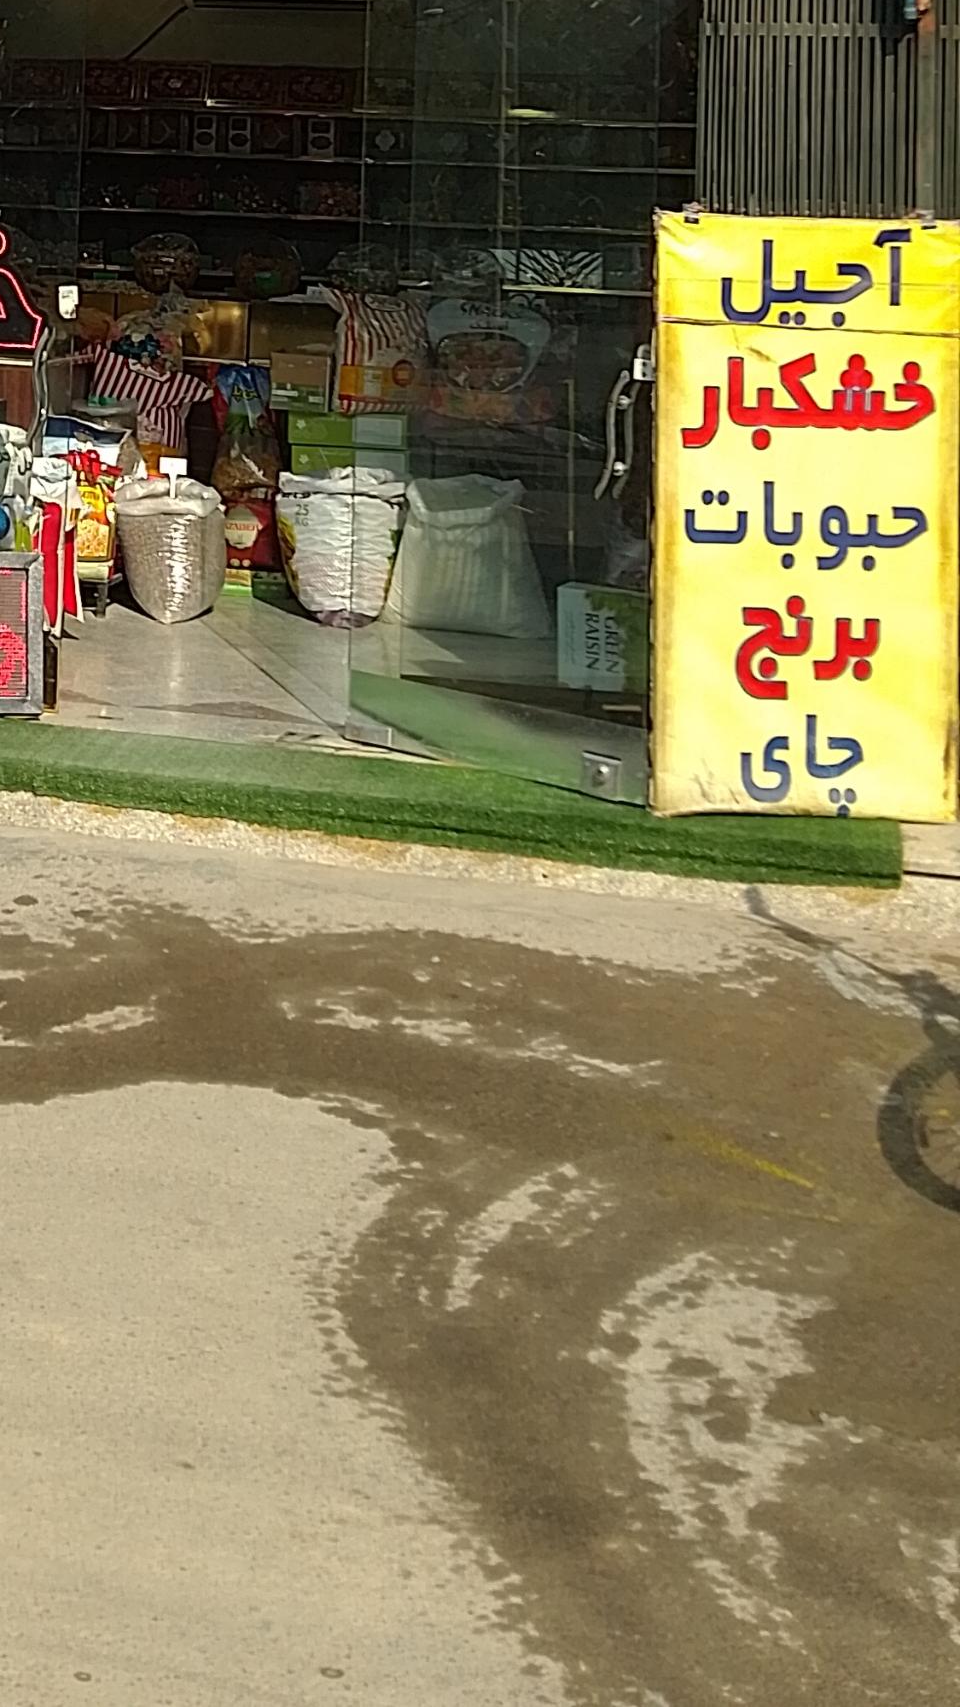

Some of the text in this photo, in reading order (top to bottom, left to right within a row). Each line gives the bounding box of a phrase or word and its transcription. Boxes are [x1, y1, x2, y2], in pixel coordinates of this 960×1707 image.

[720, 228, 912, 327] آجیل
[681, 354, 936, 449] خشکبار
[683, 481, 929, 571] حبوبات
[585, 613, 601, 672] RAISIN
[604, 616, 620, 675] GREEN
[735, 595, 880, 700] برنج
[740, 714, 864, 817] چای
